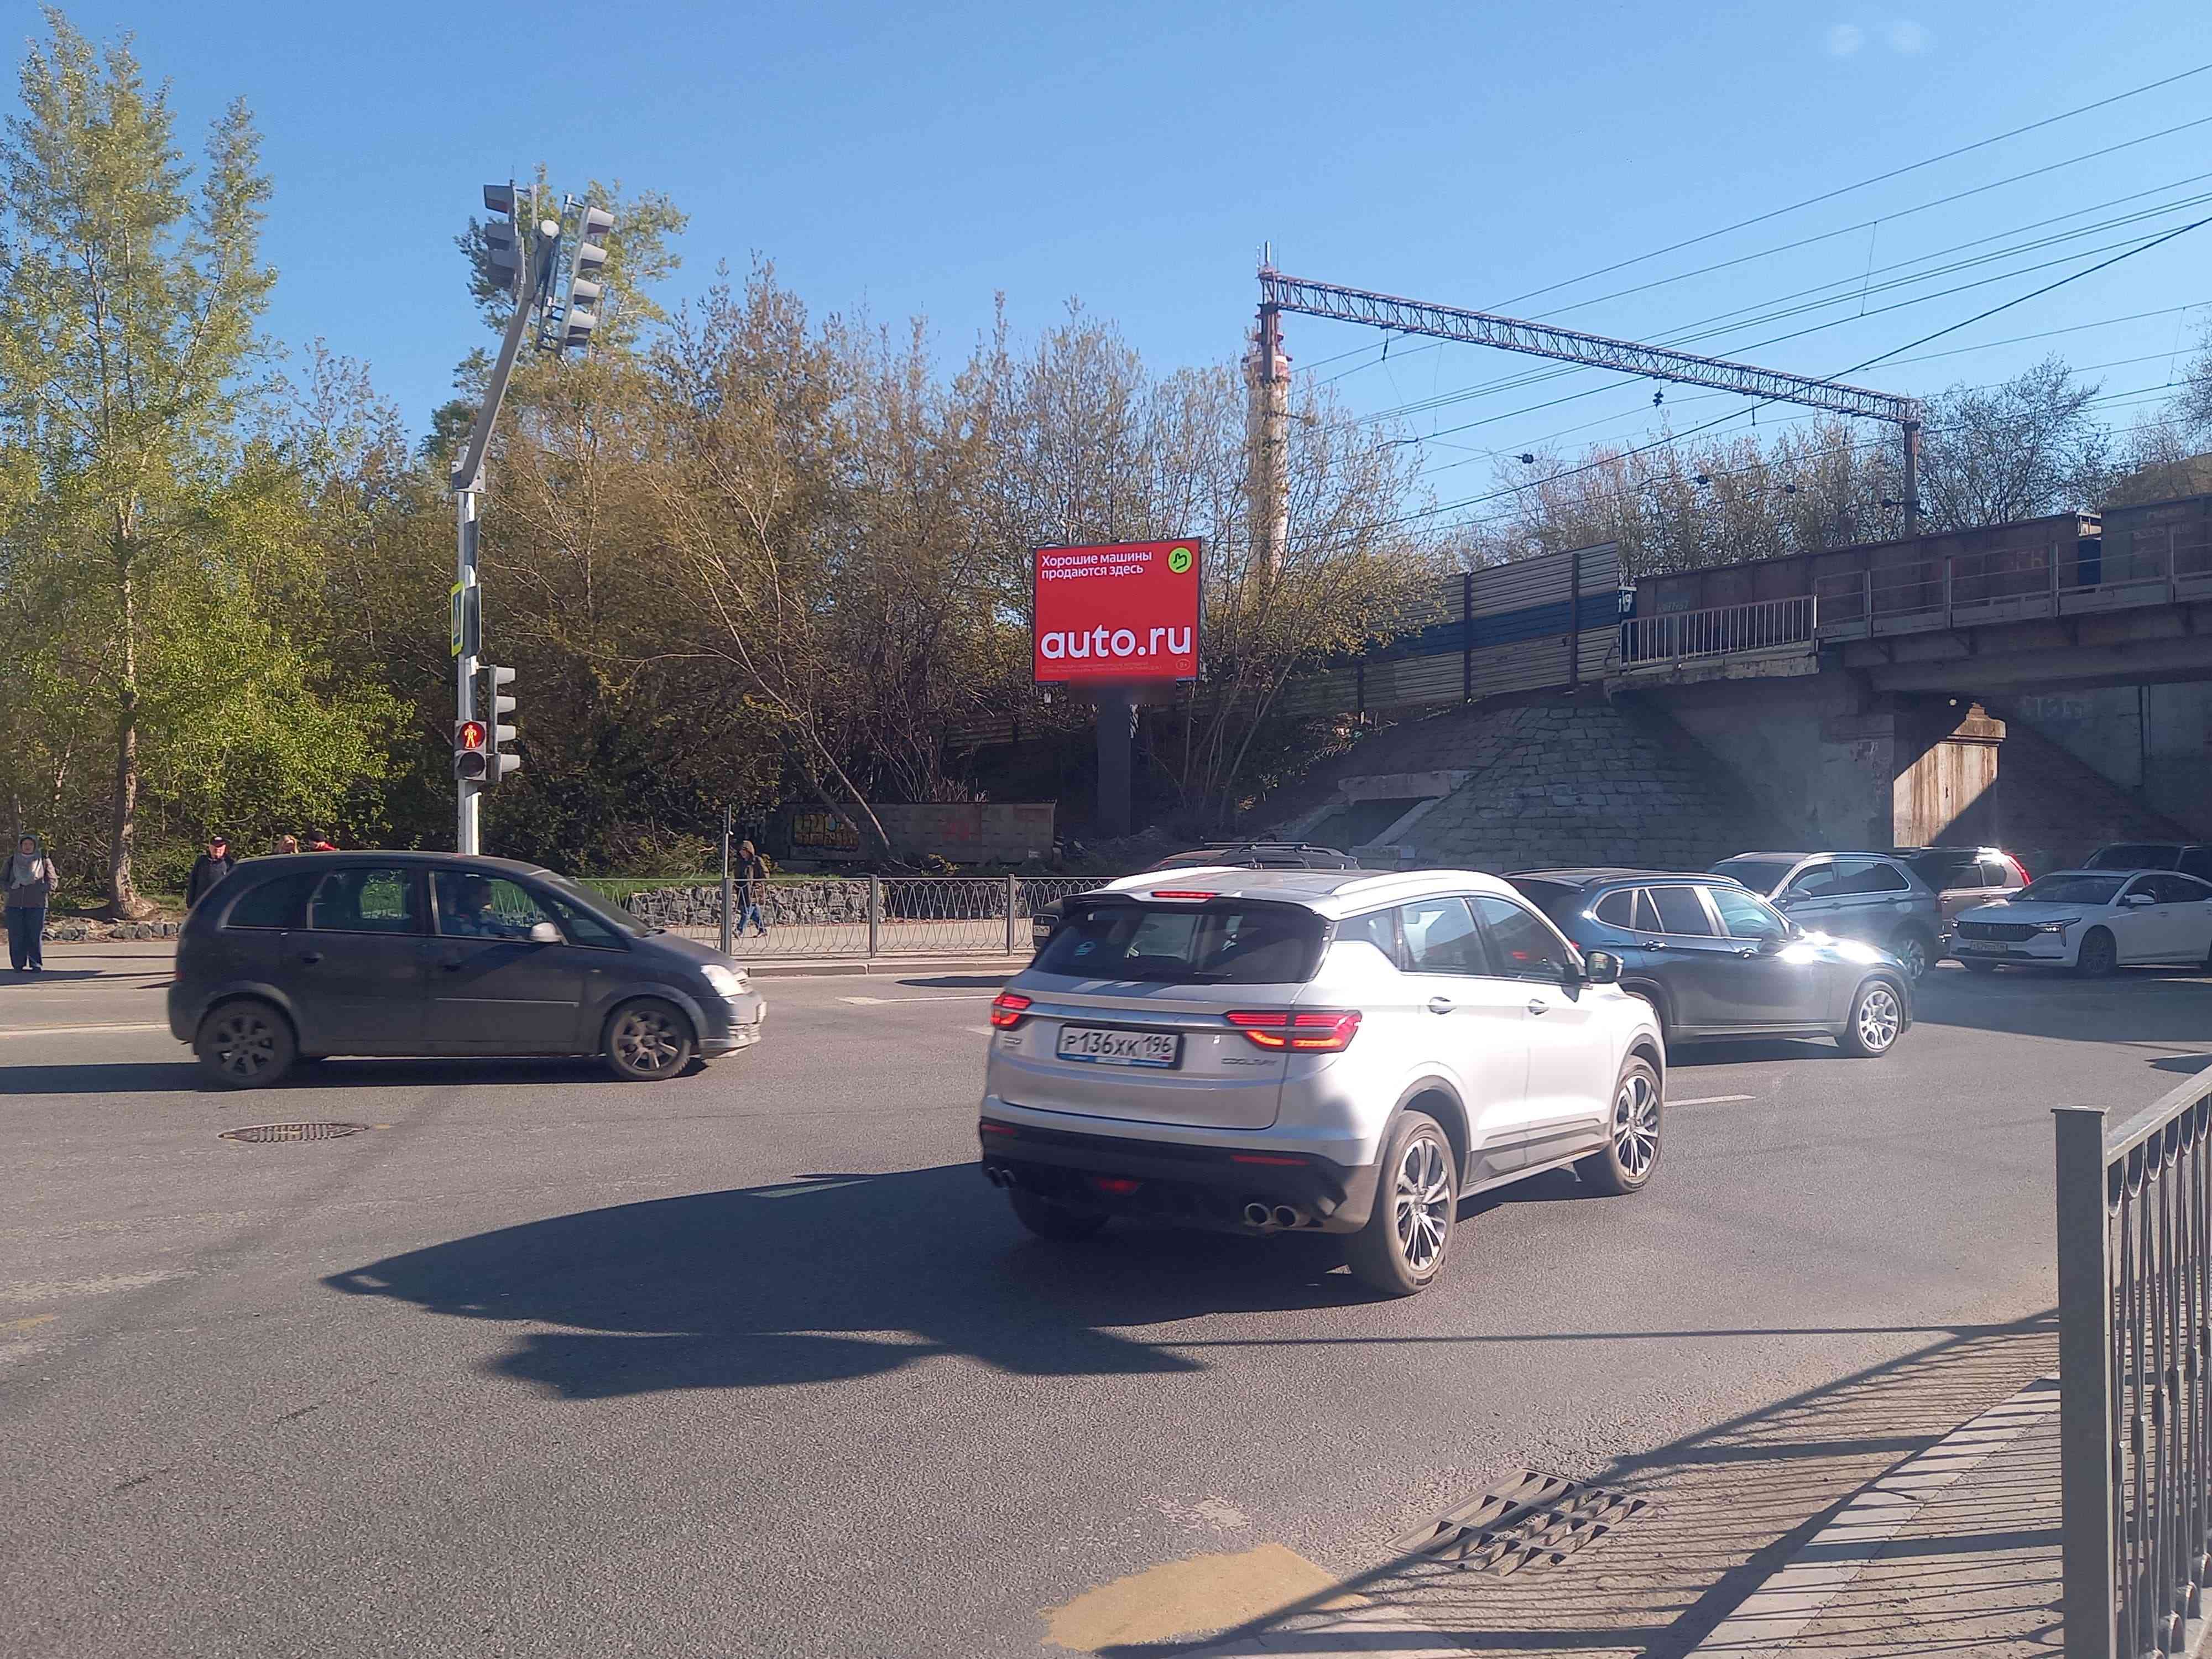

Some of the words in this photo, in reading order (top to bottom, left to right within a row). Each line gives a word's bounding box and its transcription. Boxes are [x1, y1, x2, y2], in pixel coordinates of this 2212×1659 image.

[1042, 555, 1097, 568] Хорошие
[1100, 551, 1152, 564] машины
[1042, 566, 1107, 581] продаются
[1109, 564, 1144, 577] здесь
[1041, 624, 1191, 659] auto.ru
[1142, 1035, 1173, 1053] 196
